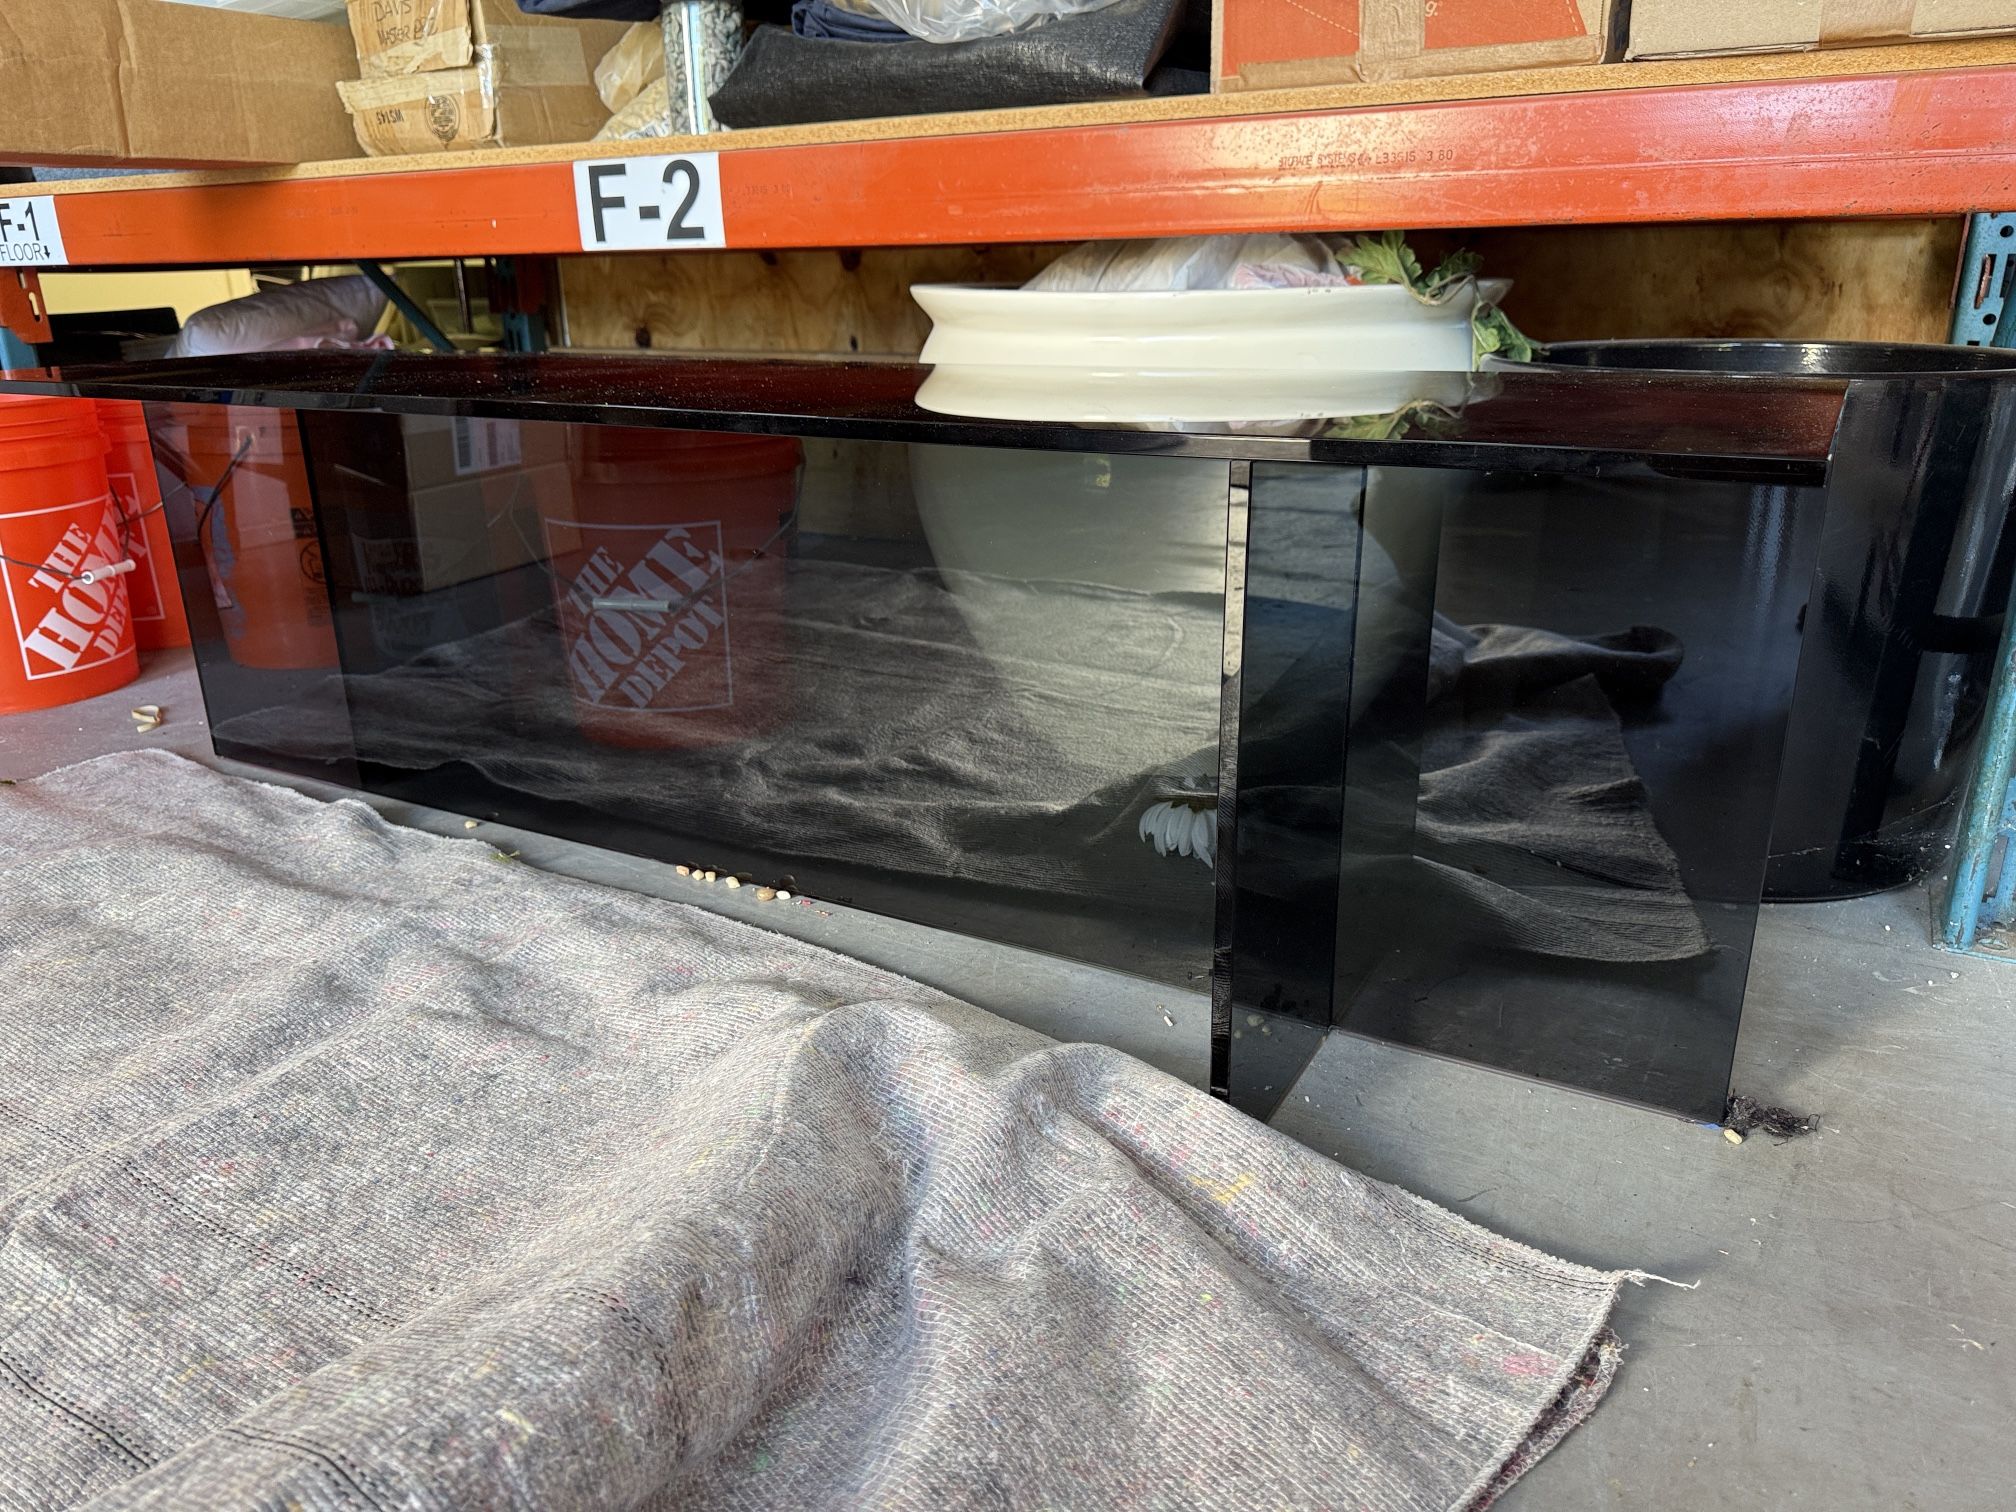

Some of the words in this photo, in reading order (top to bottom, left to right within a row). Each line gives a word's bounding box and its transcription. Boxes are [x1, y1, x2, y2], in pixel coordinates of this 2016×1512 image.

[0, 201, 40, 242] F-1
[588, 159, 705, 242] F-2
[0, 243, 44, 261] FLOOR
[28, 523, 92, 594] THE
[566, 546, 625, 618] THE
[569, 527, 721, 704] HOME
[618, 595, 725, 709] DEPOT
